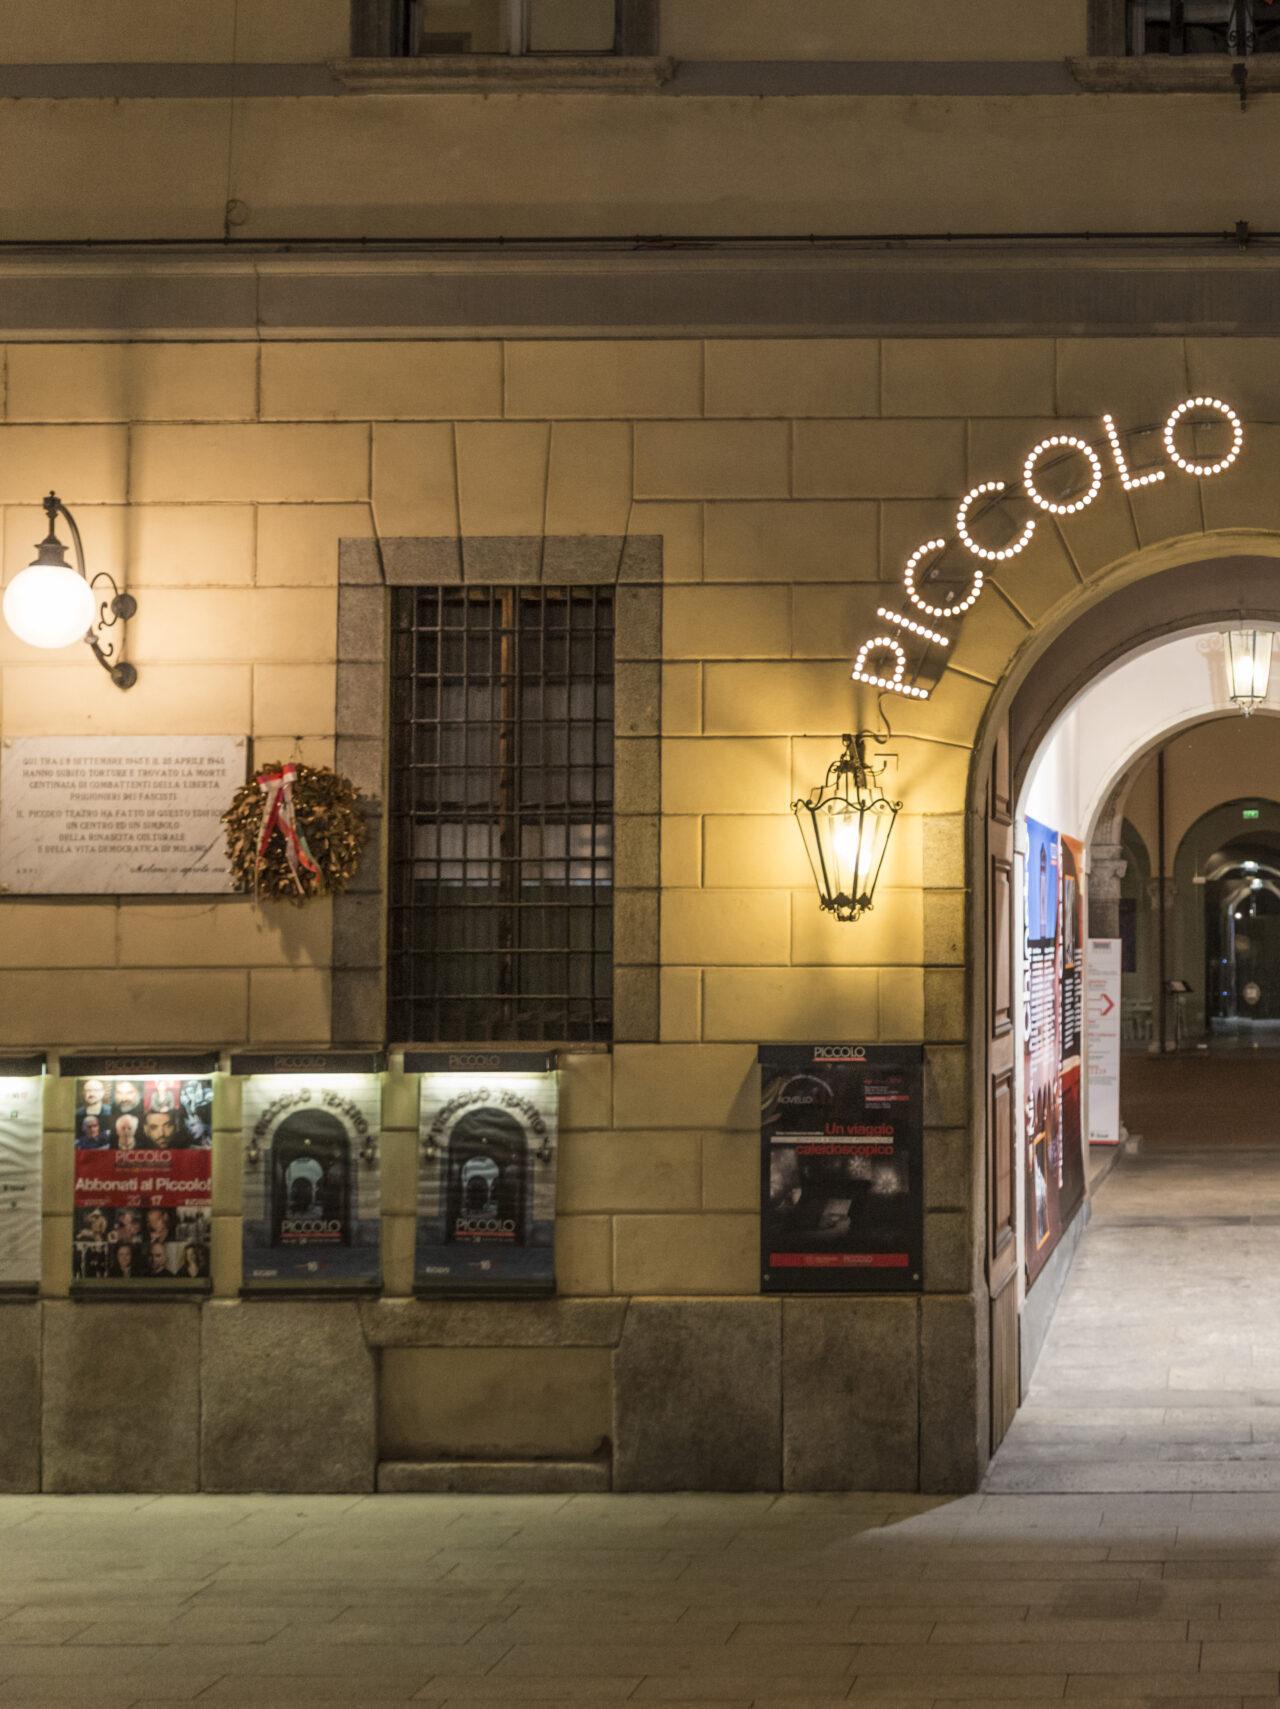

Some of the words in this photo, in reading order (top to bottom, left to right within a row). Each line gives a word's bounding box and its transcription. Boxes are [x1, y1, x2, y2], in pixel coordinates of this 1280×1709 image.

[851, 396, 1243, 699] PICCOLO
[181, 769, 193, 777] LA
[814, 1046, 866, 1058] PICCOLO
[824, 1122, 845, 1135] Un
[847, 1123, 895, 1137] viaggio
[115, 1150, 172, 1162] PICCOLO
[75, 1178, 137, 1191] Abbonati
[140, 1178, 153, 1191] al
[156, 1178, 212, 1191] Piccolo!
[282, 1219, 341, 1233] PICCOLO
[456, 1219, 515, 1232] PICCOLO
